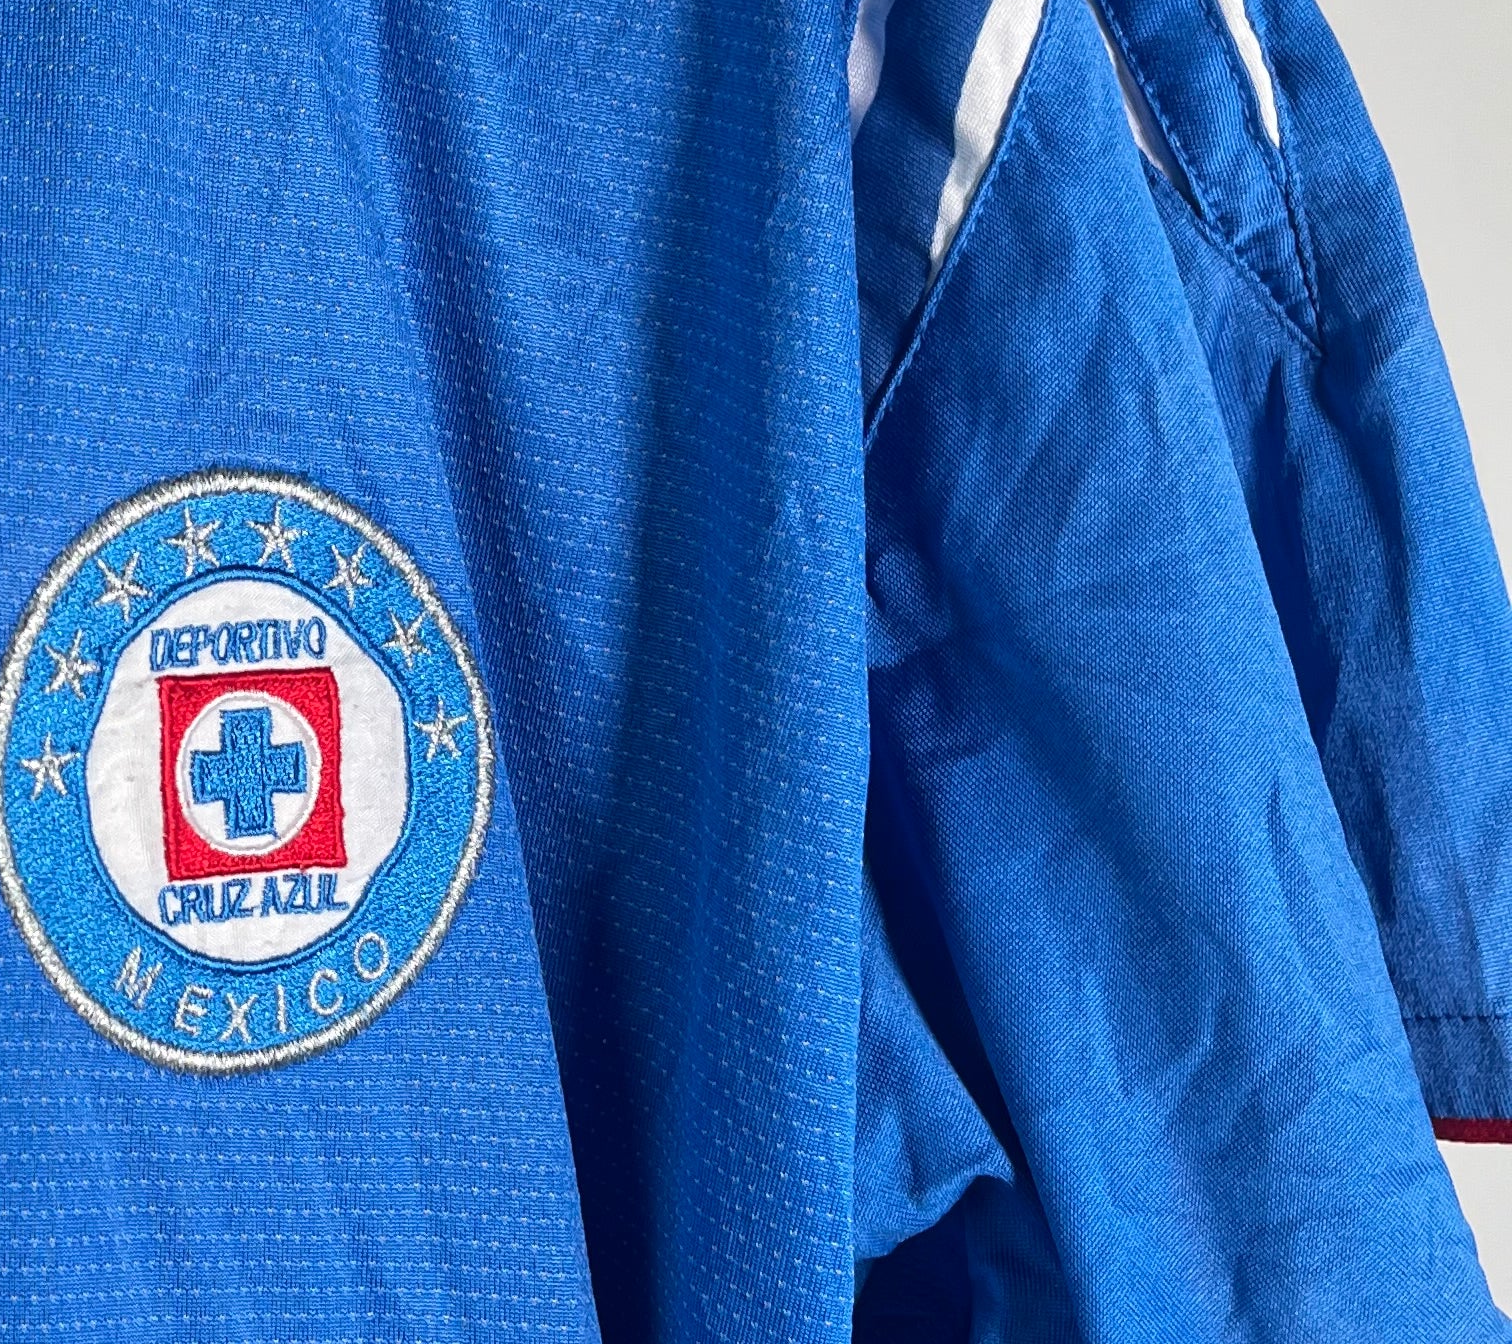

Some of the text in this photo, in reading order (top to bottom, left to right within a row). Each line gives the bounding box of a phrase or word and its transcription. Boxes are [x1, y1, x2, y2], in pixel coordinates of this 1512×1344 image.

[149, 616, 327, 671] DEPORTIVO
[157, 872, 350, 927] CRUZ AZUL
[115, 931, 390, 1043] MEXICO
